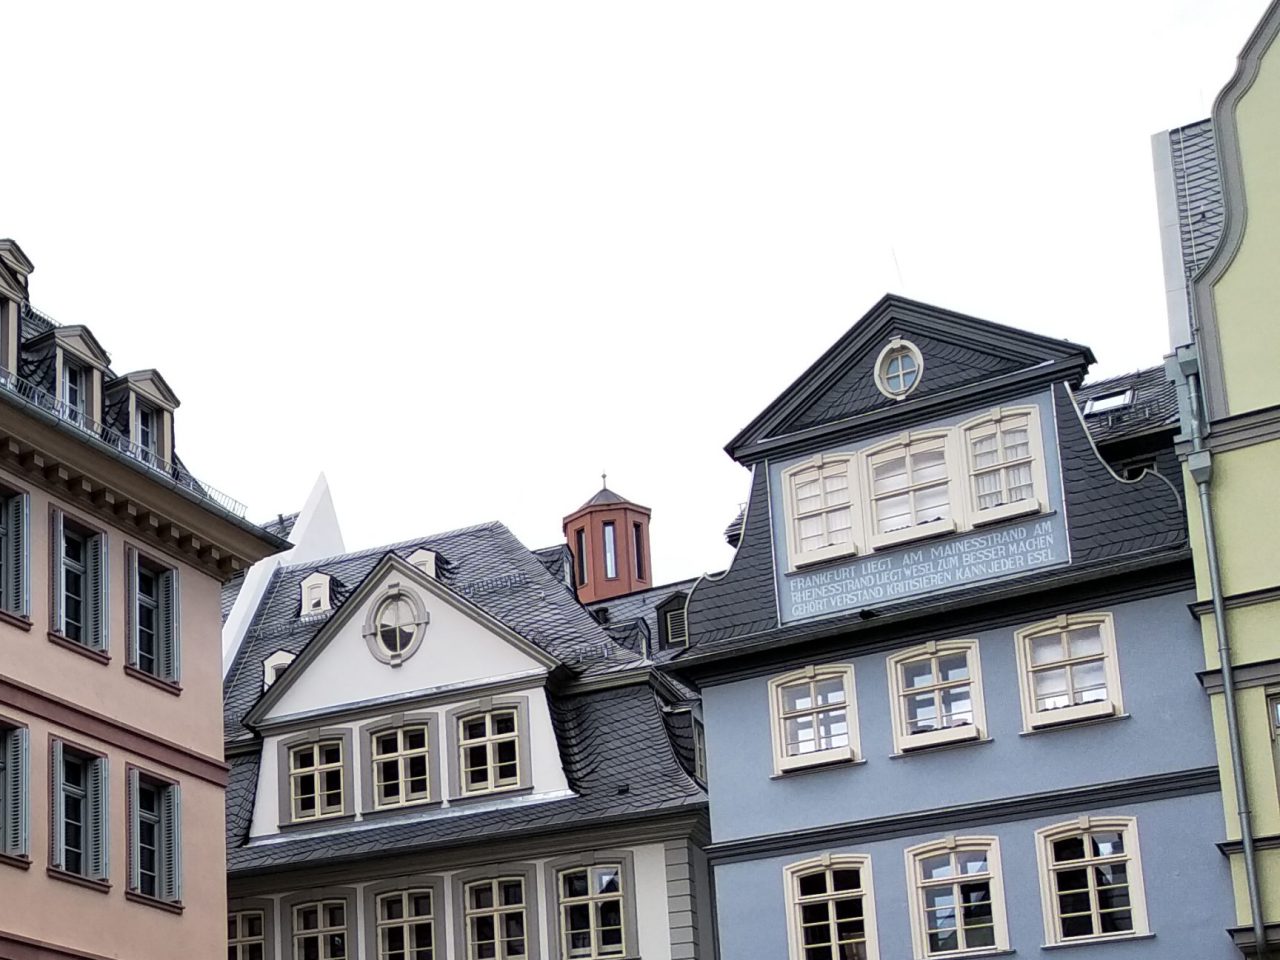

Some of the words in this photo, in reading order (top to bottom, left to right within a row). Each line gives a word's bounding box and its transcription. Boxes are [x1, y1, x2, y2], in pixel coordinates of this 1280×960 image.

[790, 565, 856, 592] FRANKFURT
[862, 557, 892, 575] LIEGT
[903, 551, 923, 566] AM
[930, 527, 1027, 560] MAINESSTRAND
[1034, 521, 1052, 537] AM
[791, 576, 875, 604] RHEINESSTRAND
[875, 568, 902, 585] LIEGT
[903, 562, 934, 578] WESEL
[936, 555, 959, 575] ZUM
[962, 545, 1006, 566] BESSER
[1009, 534, 1054, 556] MACHEN
[829, 587, 884, 607] VERSTAND
[886, 571, 952, 597] KRITISIEREN
[955, 564, 986, 580] KANN
[987, 555, 1024, 573] JEDER
[1027, 549, 1056, 565] ESEL
